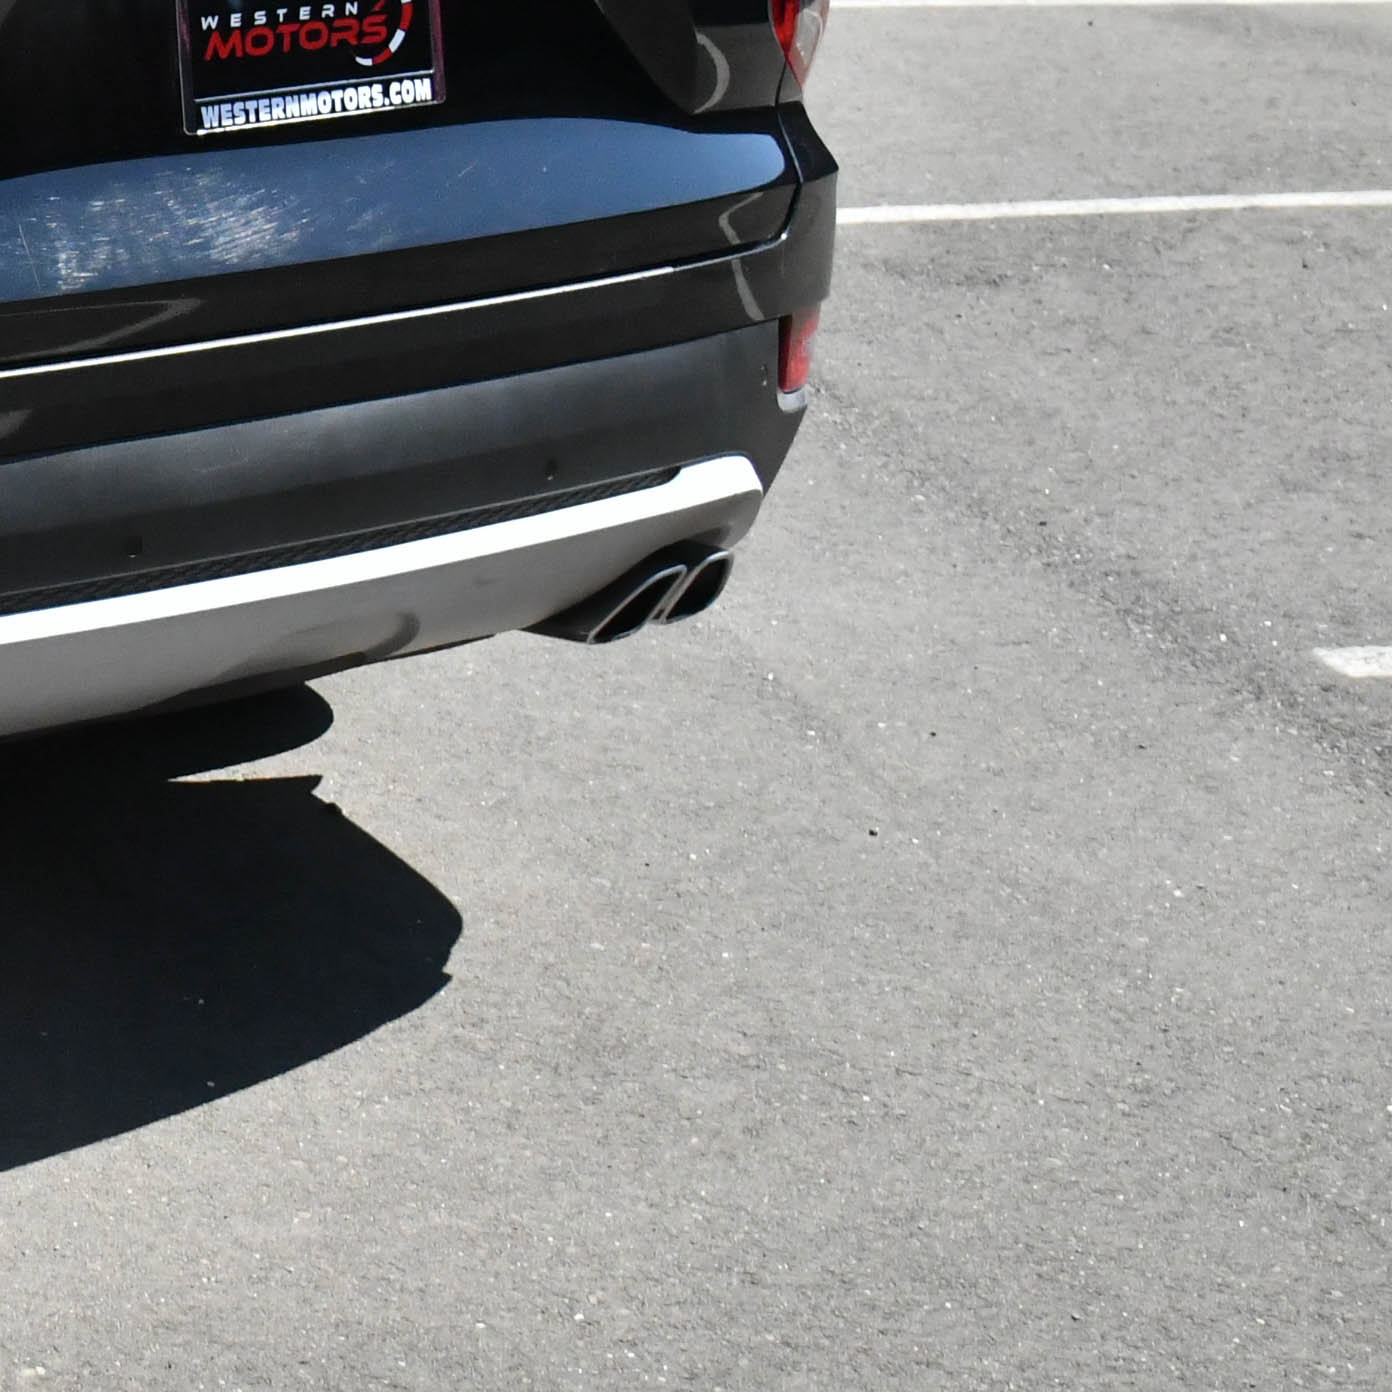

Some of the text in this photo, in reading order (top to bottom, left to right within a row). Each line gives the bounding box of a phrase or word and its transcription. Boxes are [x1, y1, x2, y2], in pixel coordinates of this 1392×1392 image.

[201, 2, 358, 30] WESTERN
[204, 14, 389, 61] MOTORS
[201, 78, 433, 128] WESTERNMOTORS.COM
